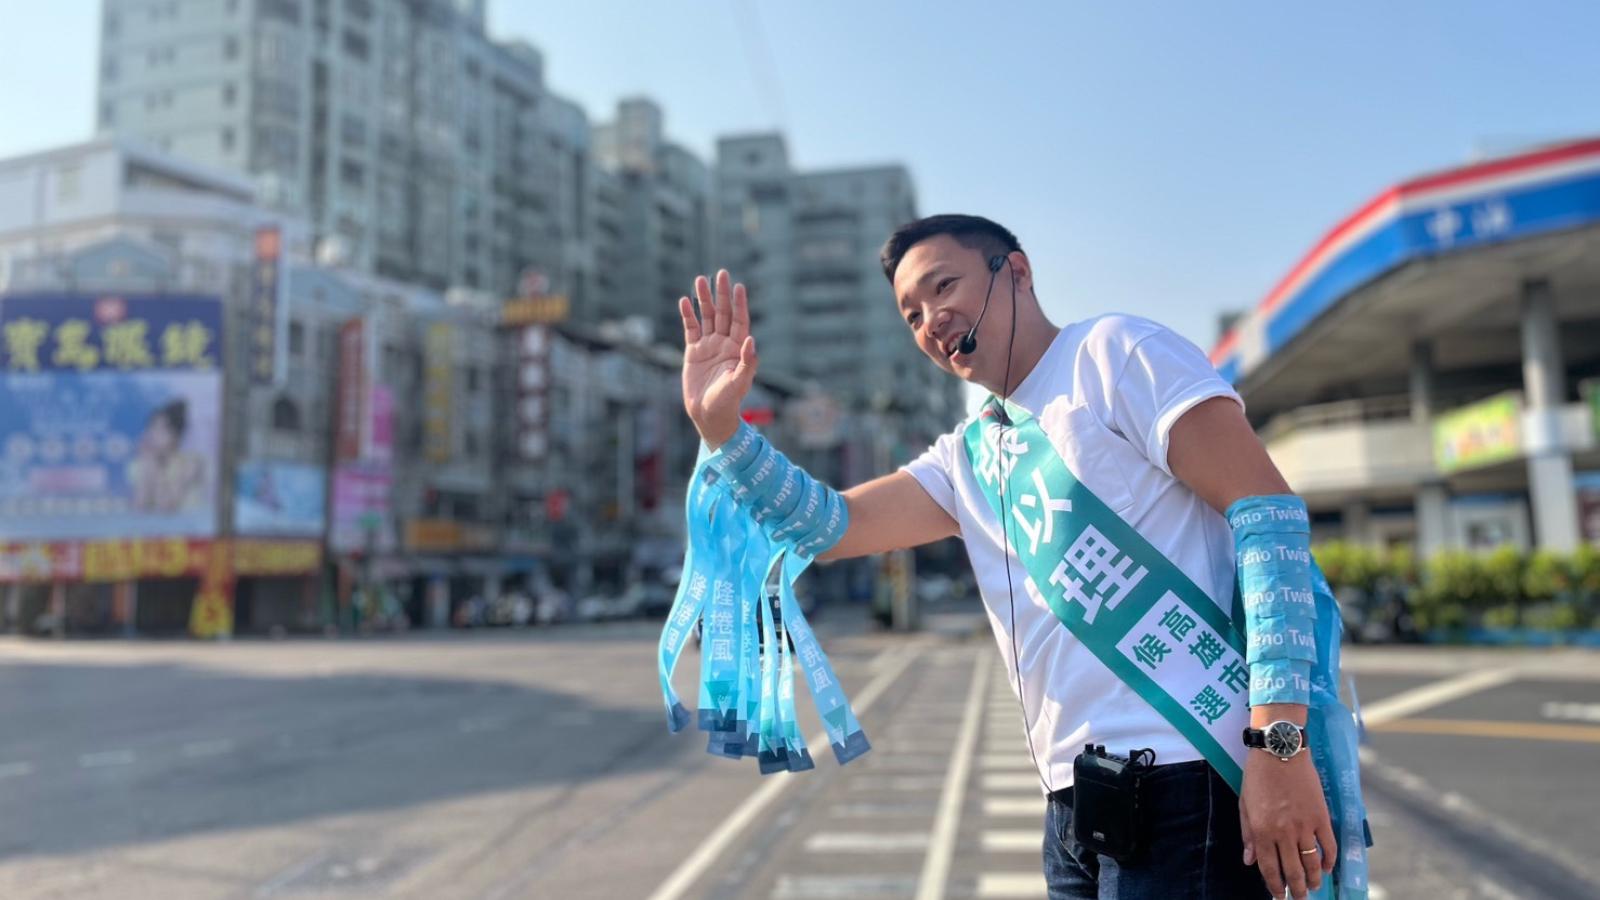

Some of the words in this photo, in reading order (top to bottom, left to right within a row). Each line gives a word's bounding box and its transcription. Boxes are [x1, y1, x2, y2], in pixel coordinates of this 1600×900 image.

[1279, 586, 1315, 606] Twis
[1132, 633, 1231, 725] 候選
[1158, 603, 1251, 711] 高雄市
